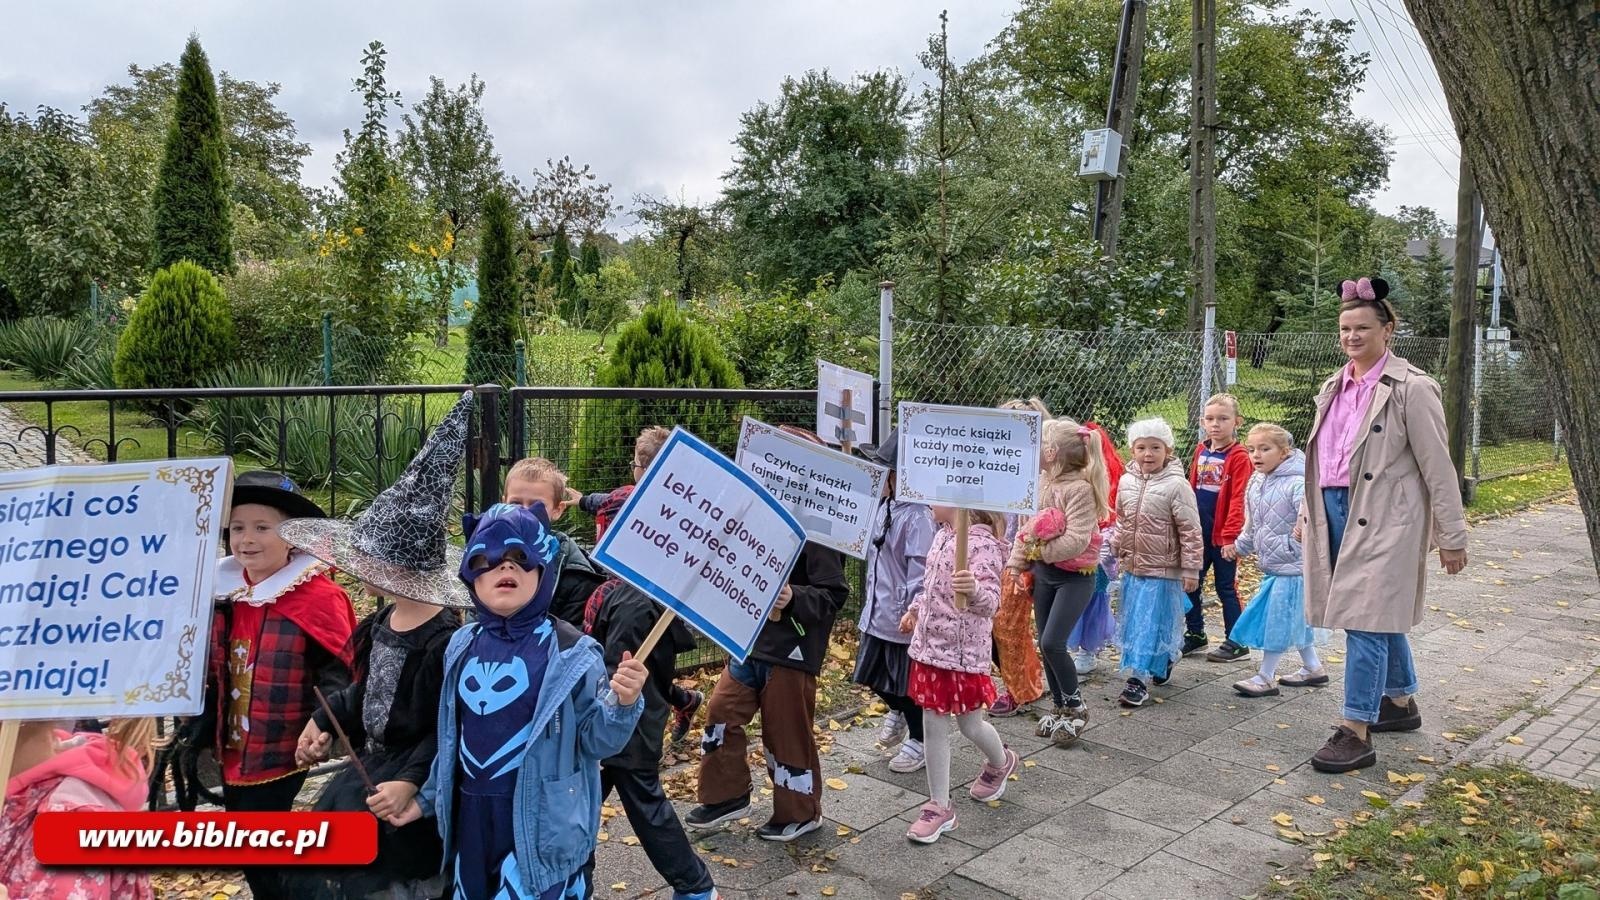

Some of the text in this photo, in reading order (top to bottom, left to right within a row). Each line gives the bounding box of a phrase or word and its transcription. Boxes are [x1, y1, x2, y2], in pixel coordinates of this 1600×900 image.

[913, 439, 1022, 458] każdy może, więc
[925, 424, 1011, 441] Czytać książki
[764, 452, 852, 492] Czytać książki
[914, 456, 1020, 475] czytaj je o każdej
[946, 474, 984, 485] porze!
[84, 485, 140, 516] coś
[751, 462, 858, 510] fajnie jest, ten kto
[780, 490, 802, 505] jest
[804, 499, 825, 512] the
[828, 506, 858, 525] best!
[662, 472, 786, 576] Lek na głowę jest
[0, 533, 167, 564] icznego w
[659, 504, 768, 593] w aptece, a na
[101, 570, 179, 599] Całe
[630, 518, 762, 621] nudę w bibliotece
[0, 614, 164, 647] człowieka
